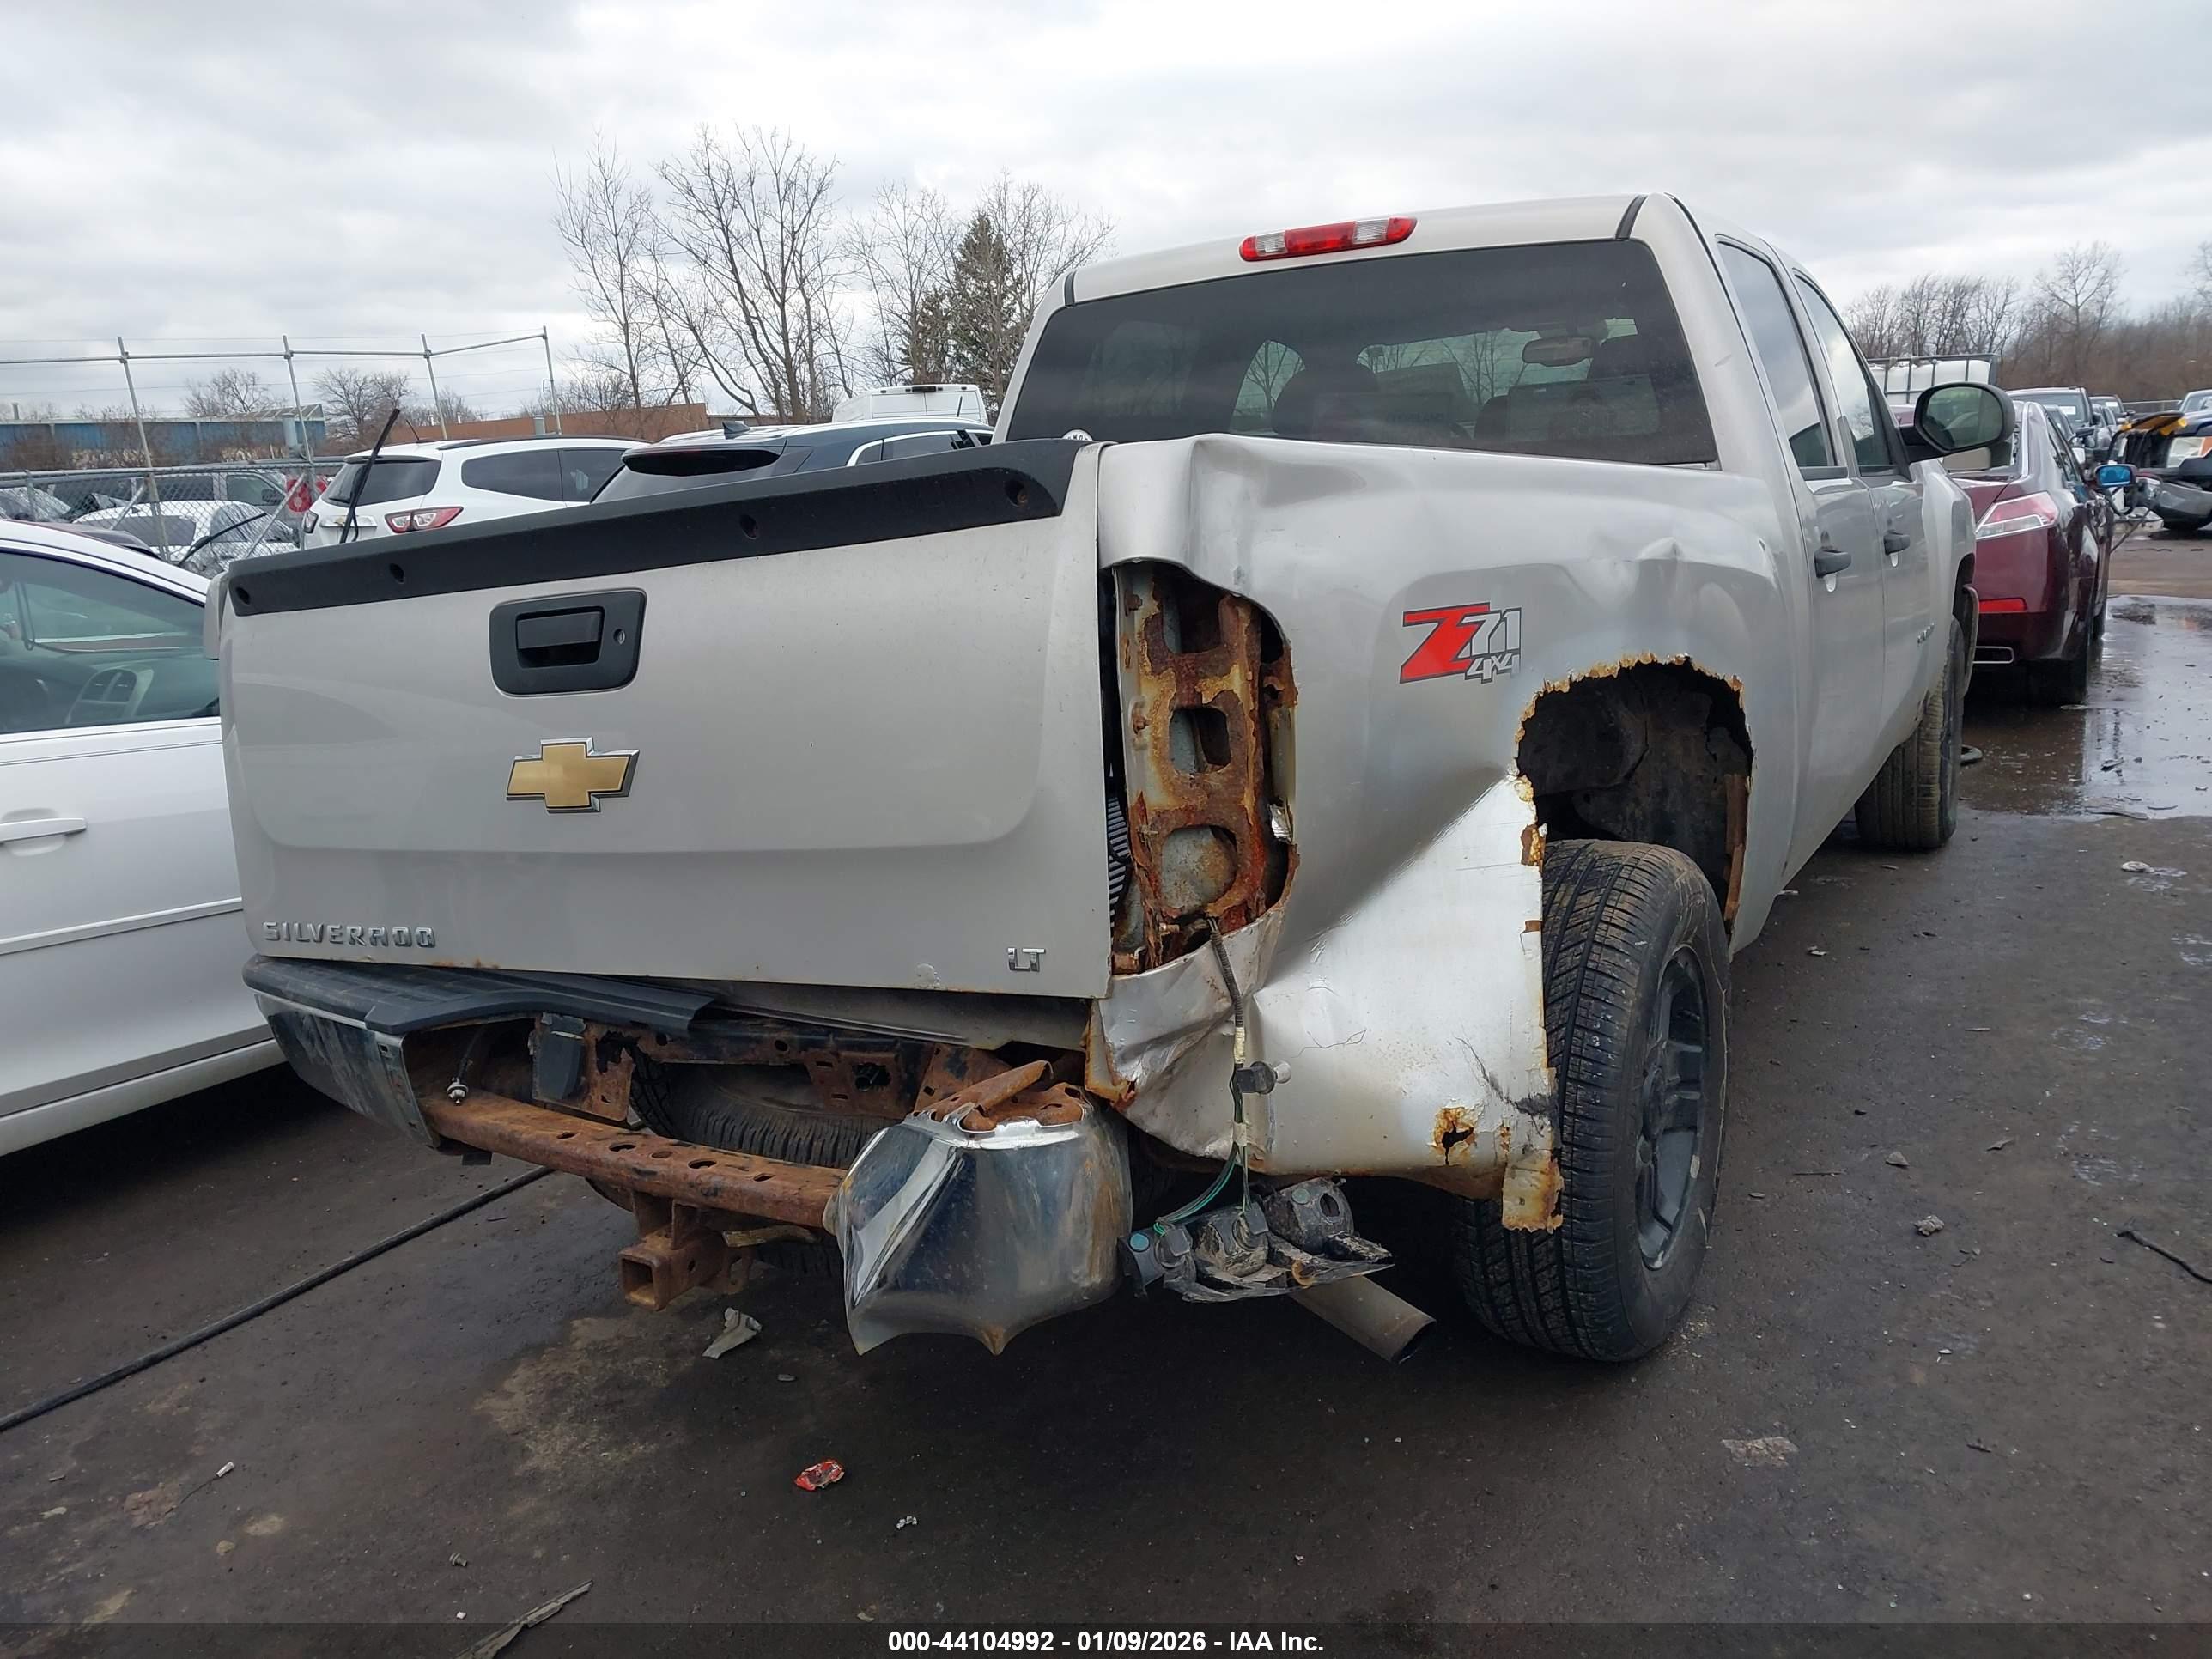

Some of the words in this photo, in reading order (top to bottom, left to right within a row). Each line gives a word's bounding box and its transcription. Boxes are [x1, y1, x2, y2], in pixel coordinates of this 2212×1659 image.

[1400, 602, 1522, 684] Z71
[263, 921, 436, 948] SILVERADO
[1007, 947, 1046, 972] LT
